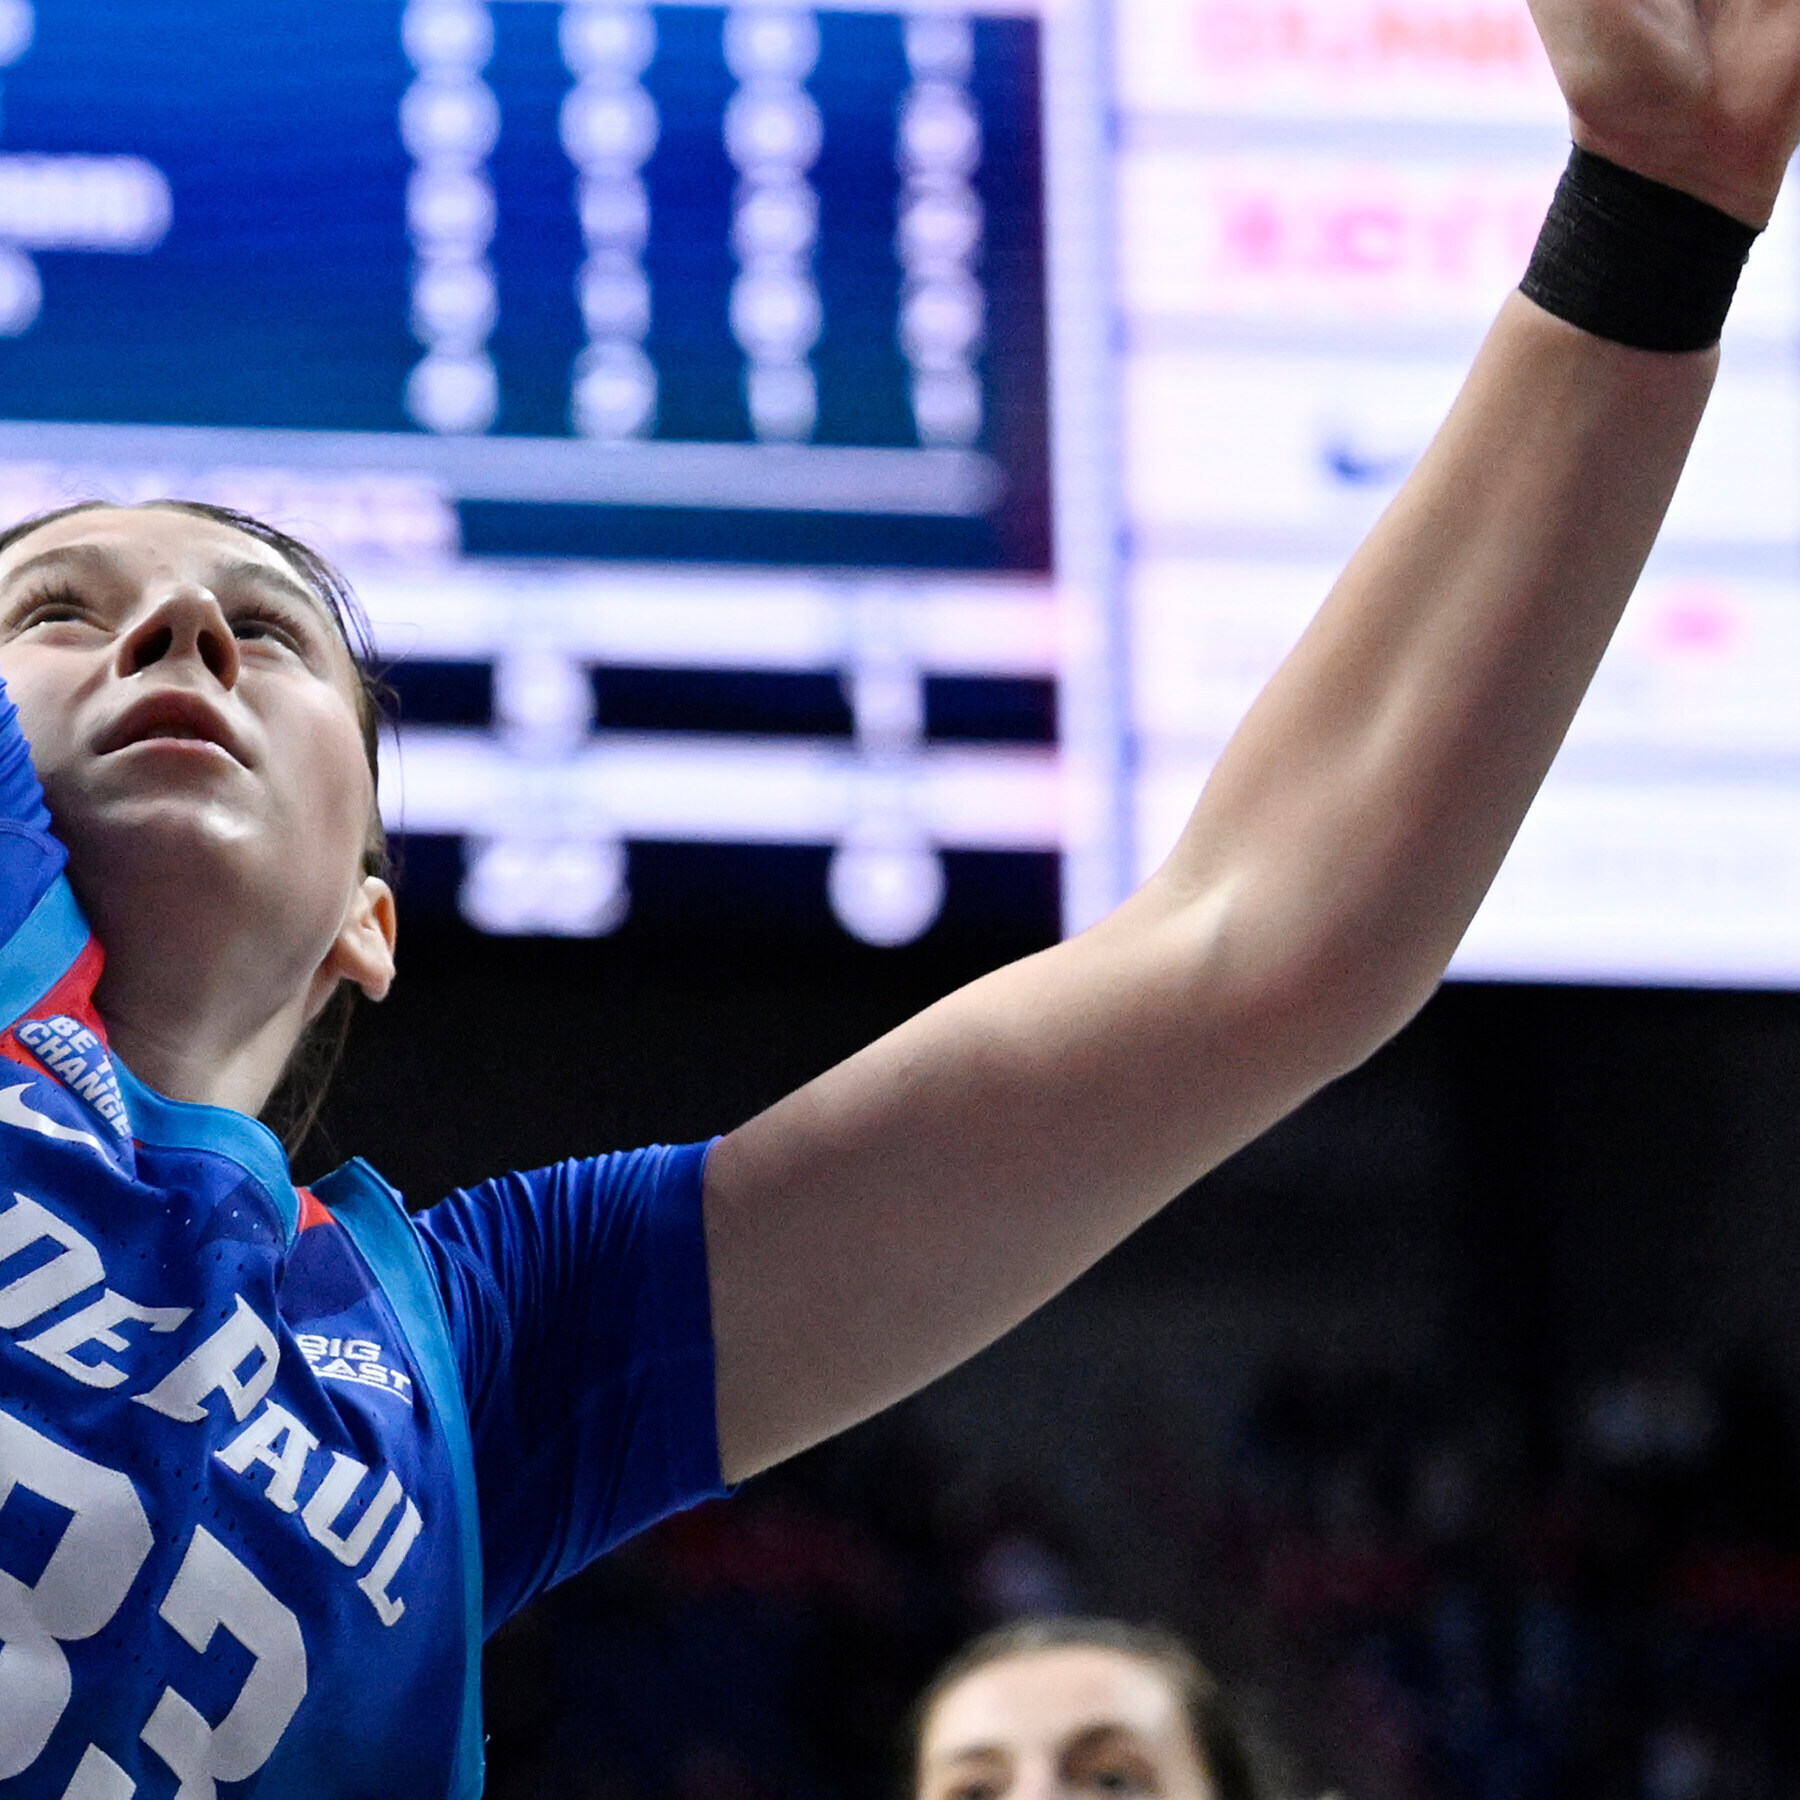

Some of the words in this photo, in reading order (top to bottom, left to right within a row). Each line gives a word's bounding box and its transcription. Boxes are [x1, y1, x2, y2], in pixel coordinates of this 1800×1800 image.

[48, 1016, 98, 1054] BE
[19, 1022, 129, 1137] CHANGE
[295, 1334, 381, 1362] BIG
[130, 1292, 425, 1628] PAUL
